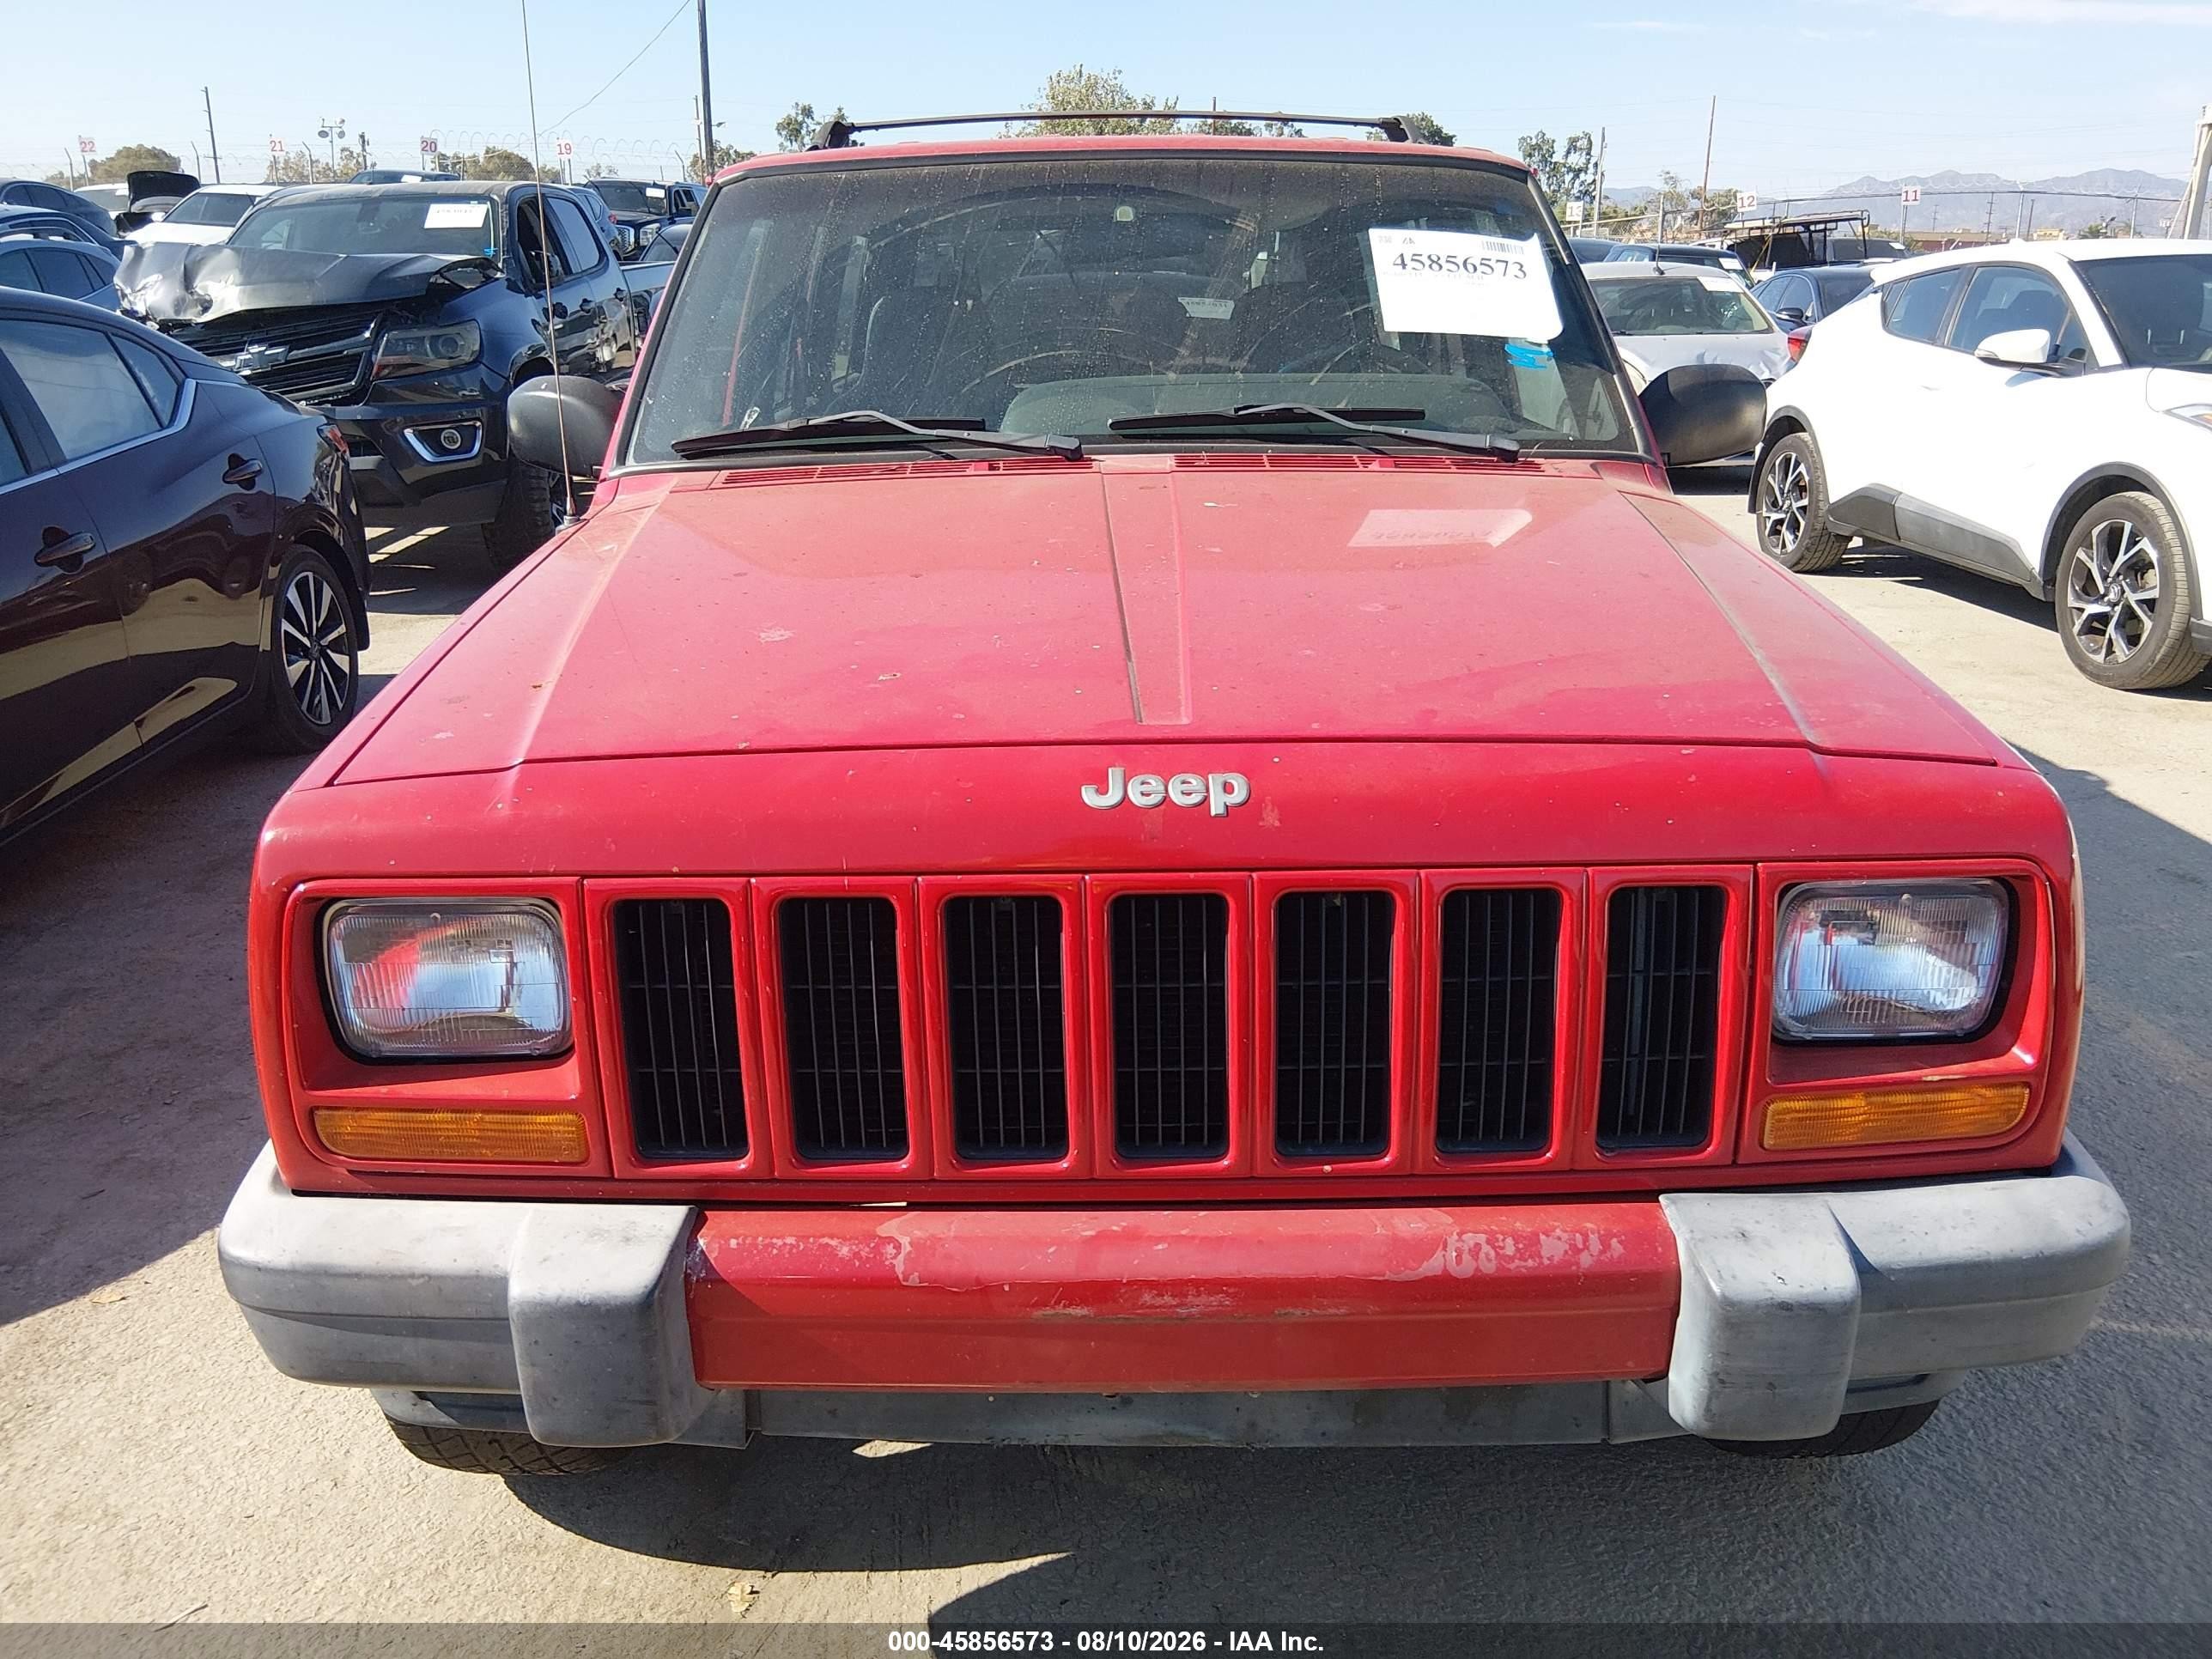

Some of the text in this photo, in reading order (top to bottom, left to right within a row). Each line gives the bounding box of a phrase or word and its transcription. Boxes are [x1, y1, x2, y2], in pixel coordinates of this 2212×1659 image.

[80, 140, 96, 153] 22
[270, 140, 284, 152] 21
[421, 140, 437, 153] 20
[556, 143, 572, 155] 19
[1738, 195, 1755, 209] 12
[1902, 189, 1919, 202] 11
[1392, 252, 1528, 280] 45856573
[1080, 766, 1251, 817] Jeep
